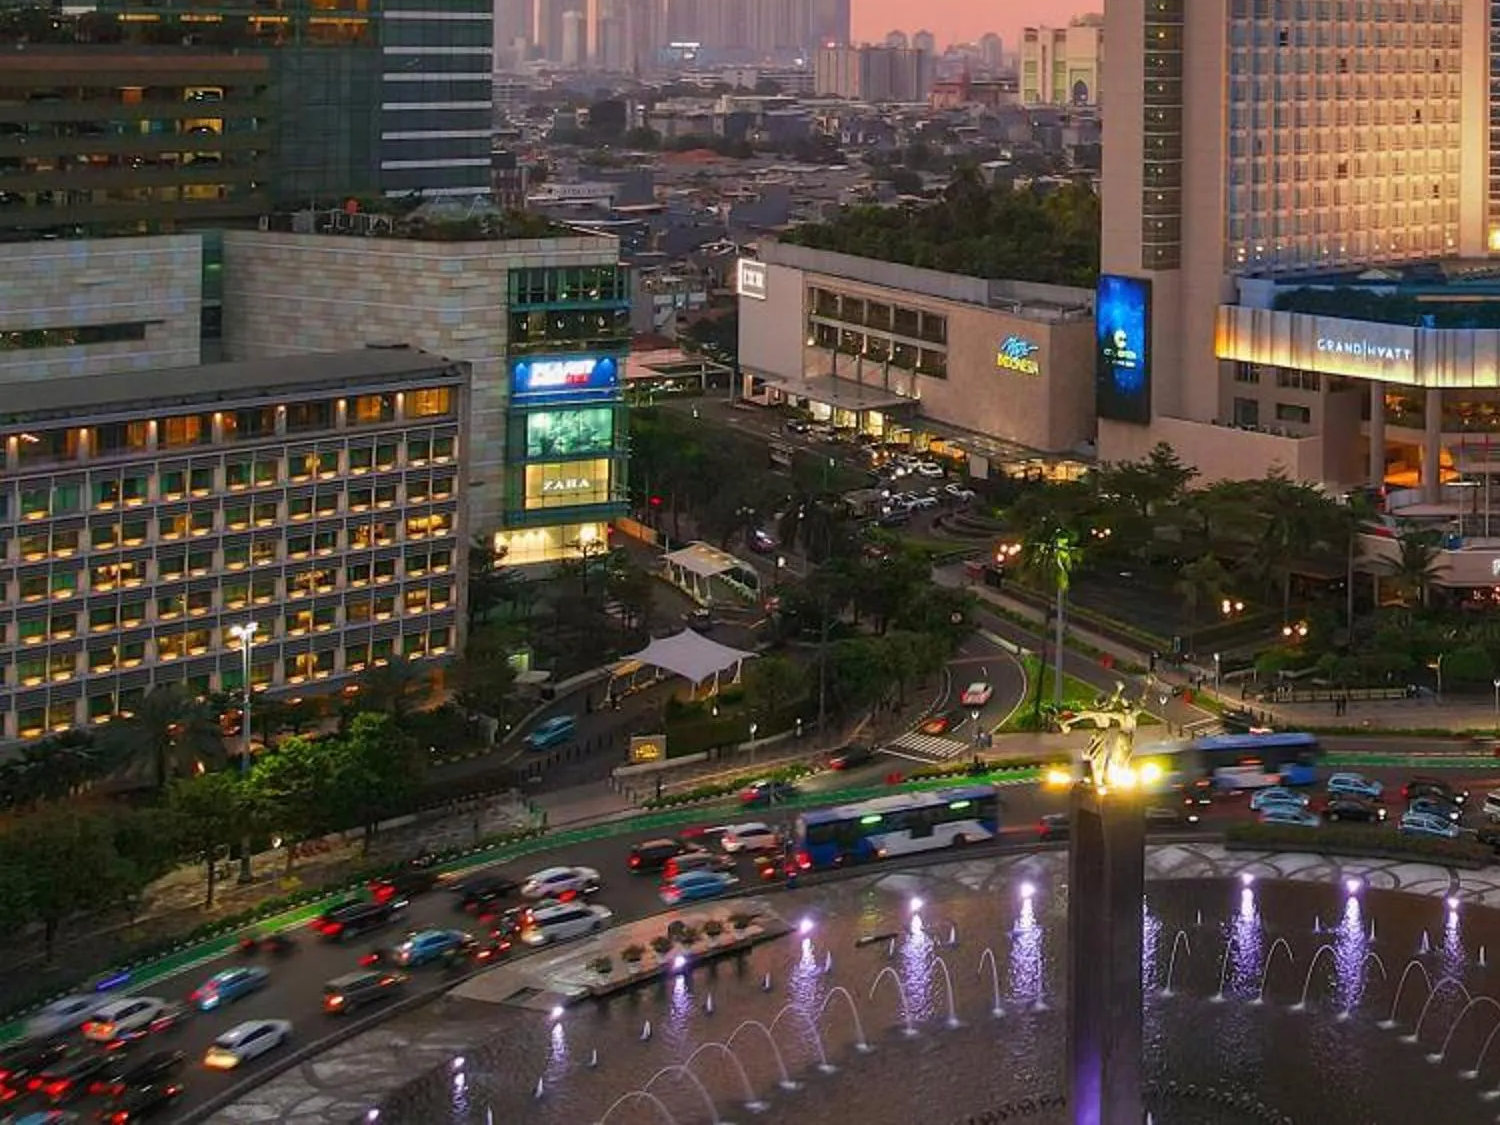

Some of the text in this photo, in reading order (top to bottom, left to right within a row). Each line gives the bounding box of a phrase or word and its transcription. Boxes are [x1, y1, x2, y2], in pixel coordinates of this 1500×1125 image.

[1317, 338, 1411, 361] GRAND HYATT
[543, 478, 590, 491] ZARA
